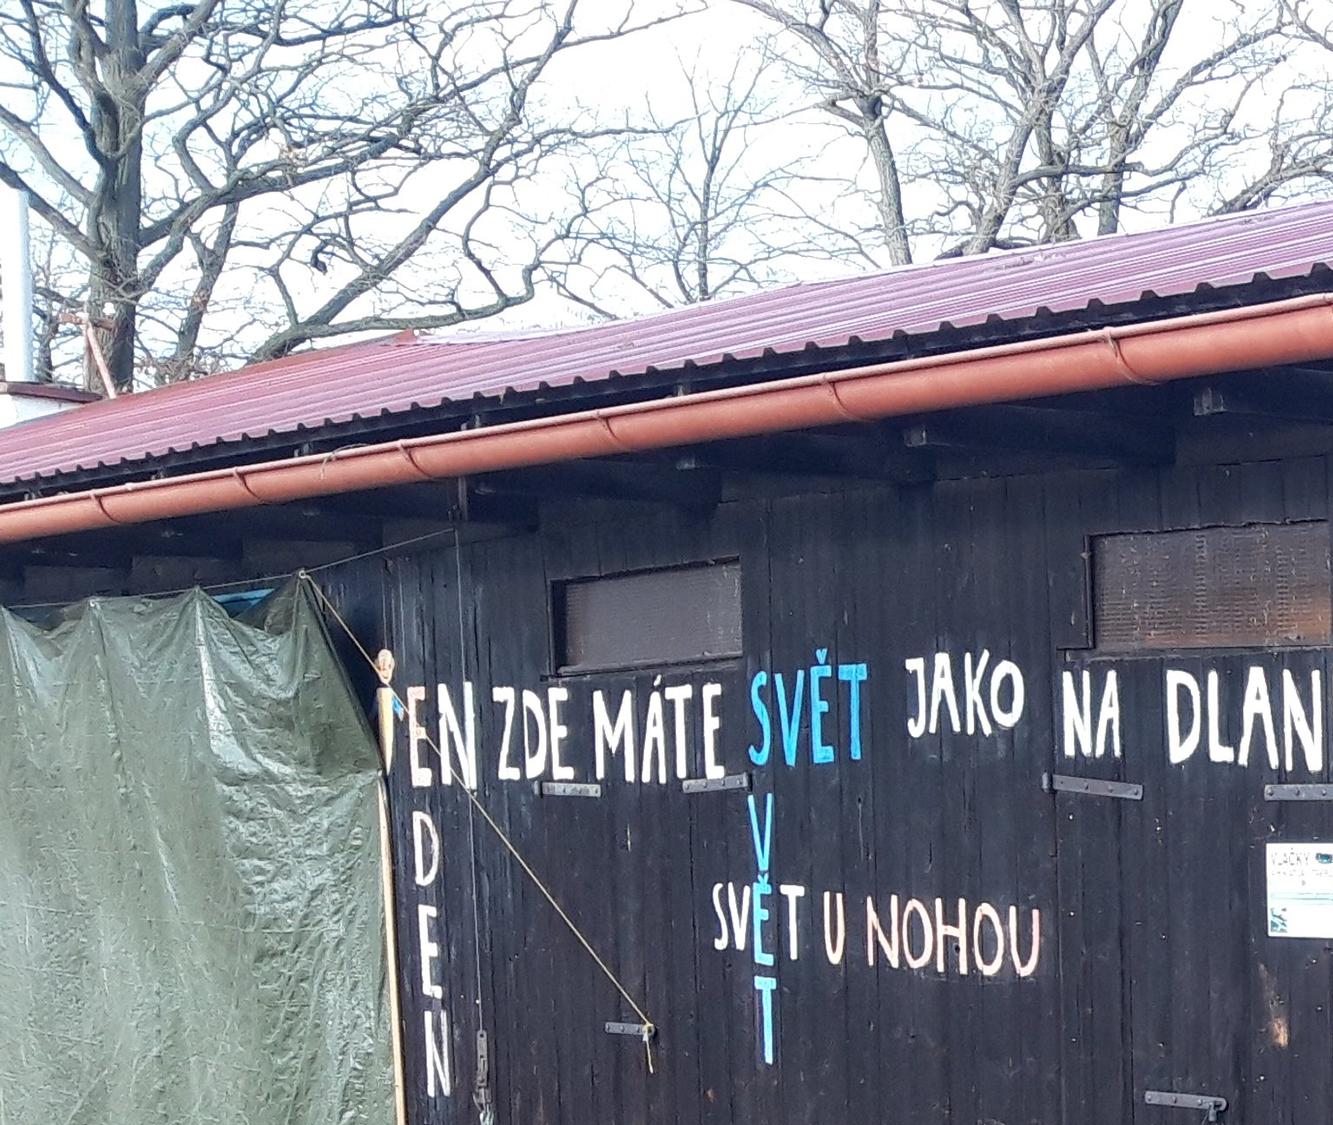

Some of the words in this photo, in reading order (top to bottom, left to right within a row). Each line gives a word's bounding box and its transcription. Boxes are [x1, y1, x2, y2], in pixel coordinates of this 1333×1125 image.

[492, 685, 575, 782] ZDE
[592, 675, 726, 784] MÁTE
[747, 648, 868, 768] SVĚT
[905, 648, 1025, 738] JAKO
[1062, 668, 1122, 758] NA
[713, 876, 806, 962] SVĚT
[822, 890, 847, 966] U
[866, 893, 1040, 977] NOHOU
